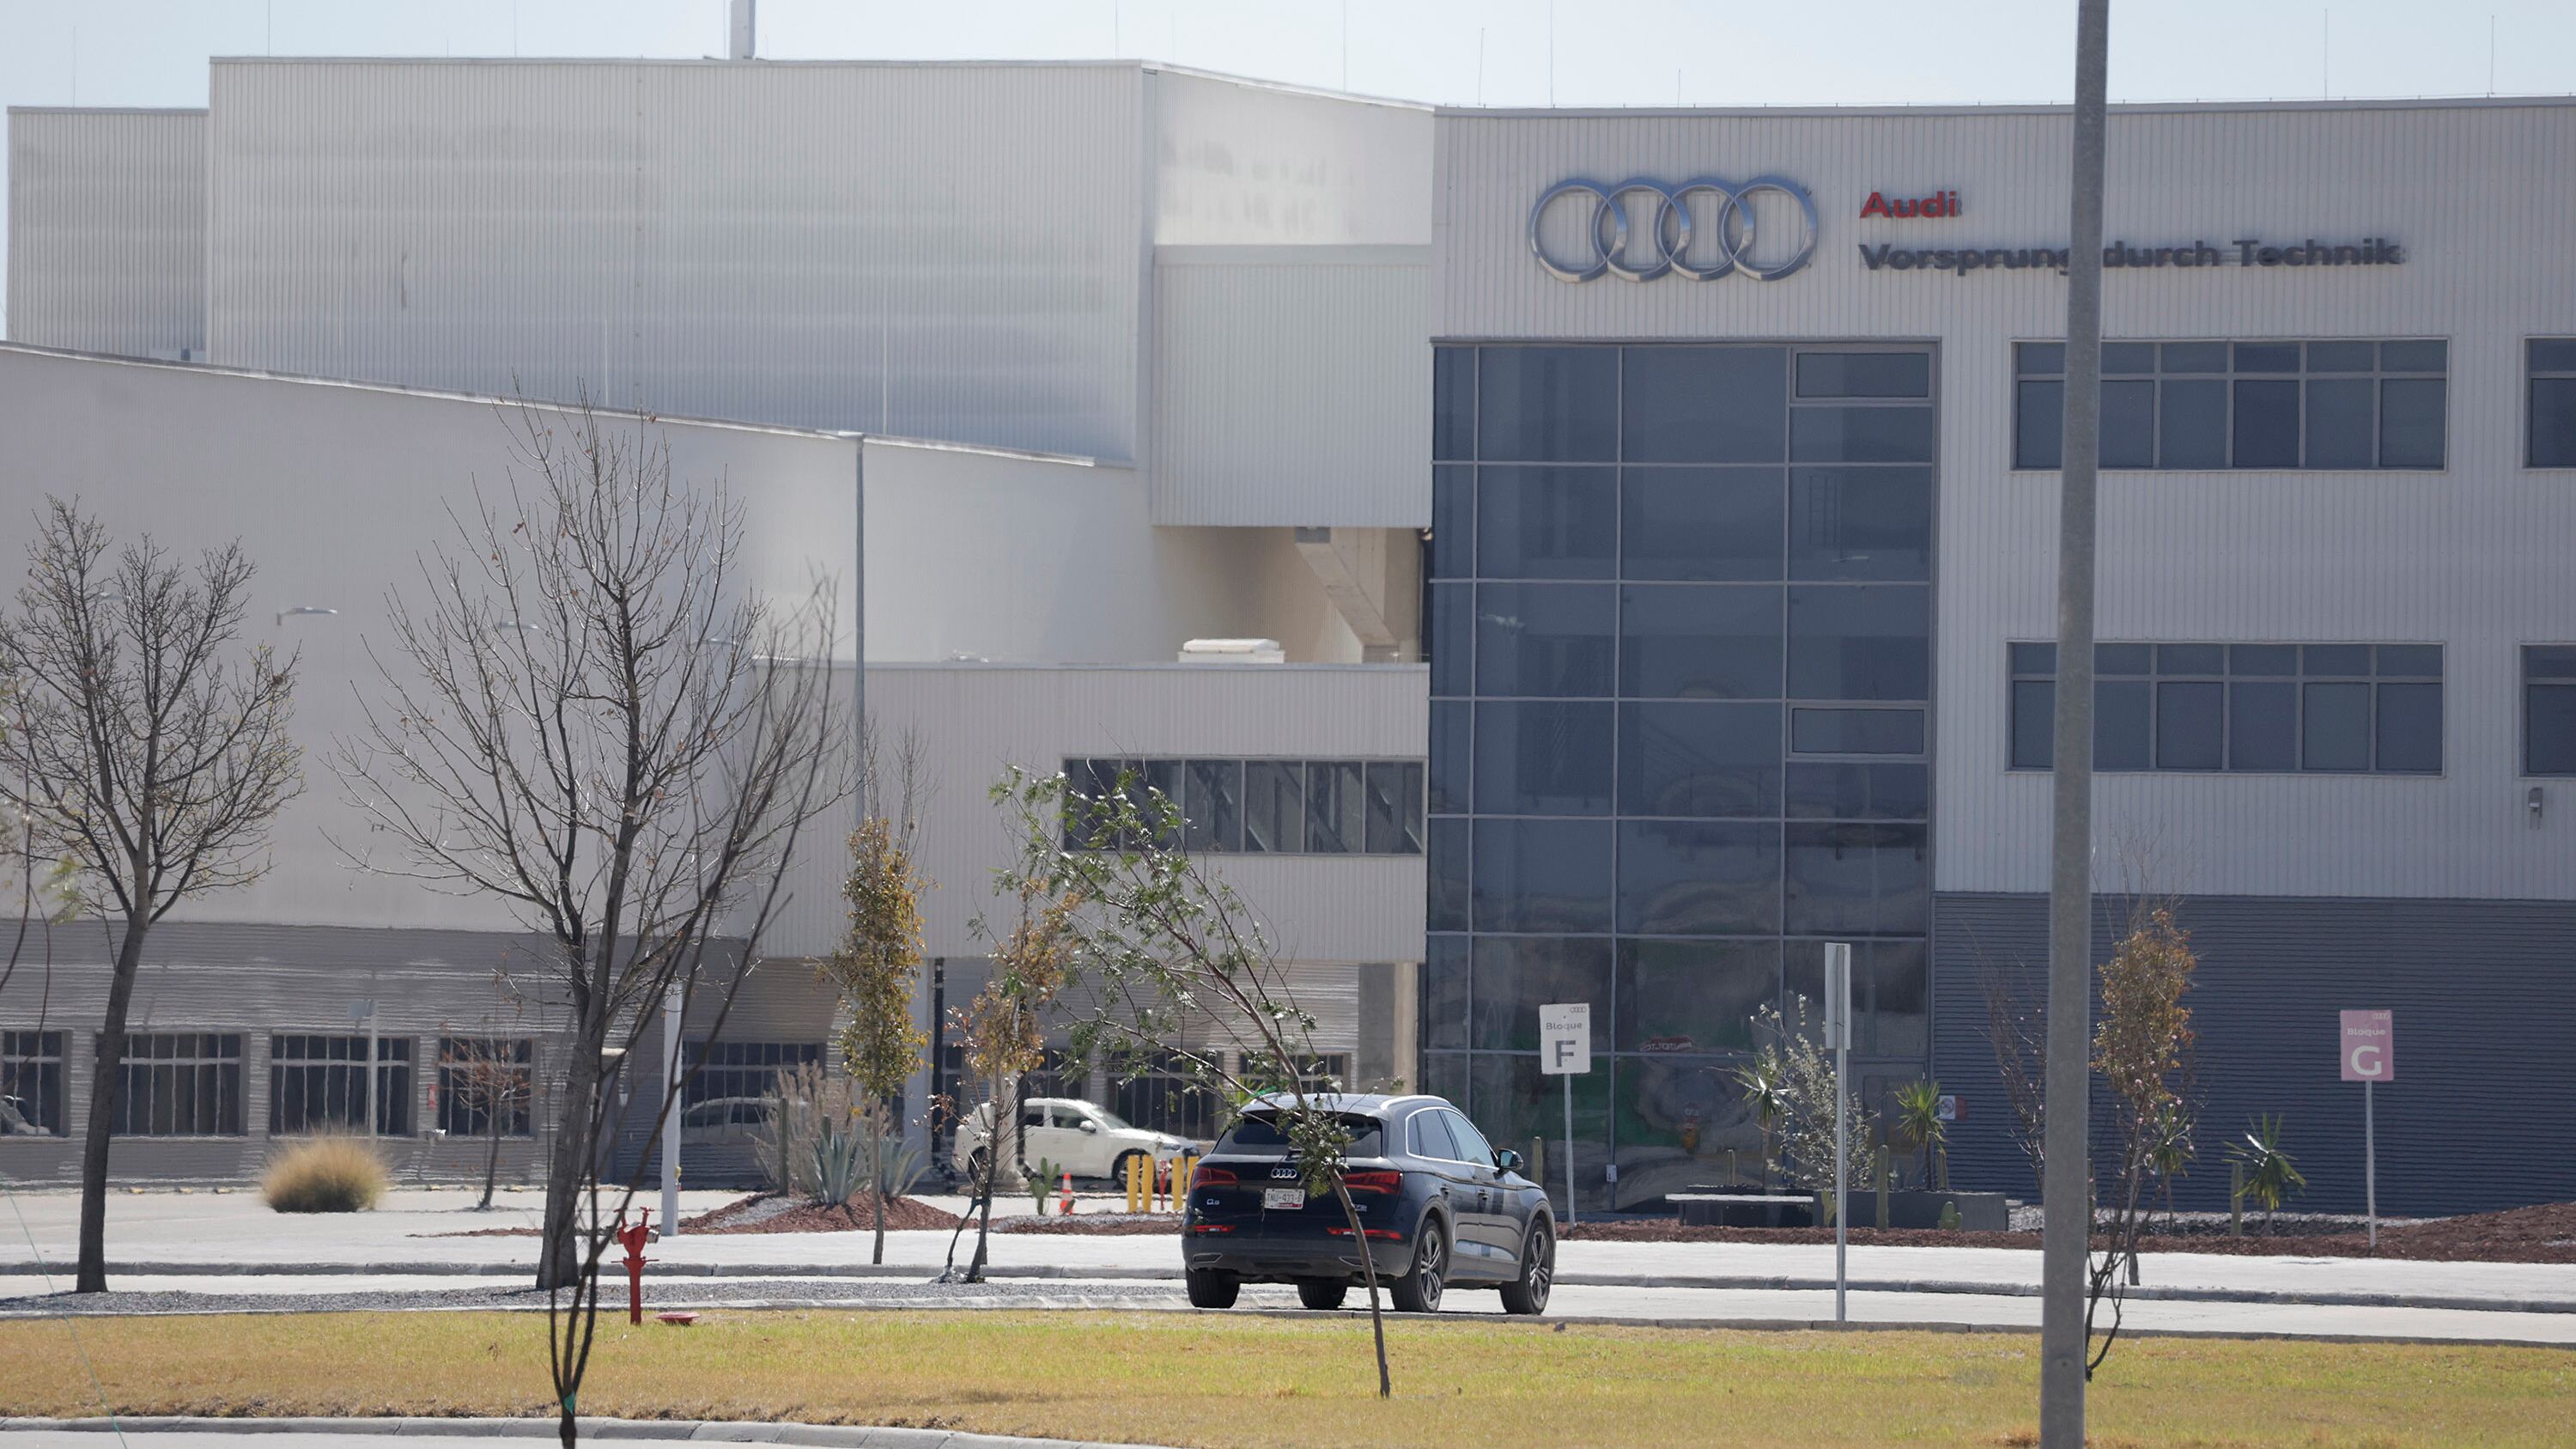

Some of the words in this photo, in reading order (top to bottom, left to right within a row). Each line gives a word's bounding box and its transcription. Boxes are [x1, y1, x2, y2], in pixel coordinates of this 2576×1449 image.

[1859, 190, 1958, 219] Audi
[2103, 240, 2222, 268] durch
[2232, 238, 2402, 267] Technik
[1546, 1021, 1583, 1032] Bloque
[2347, 1027, 2386, 1037] Bloque
[1555, 1039, 1577, 1068] F
[2351, 1044, 2383, 1075] G
